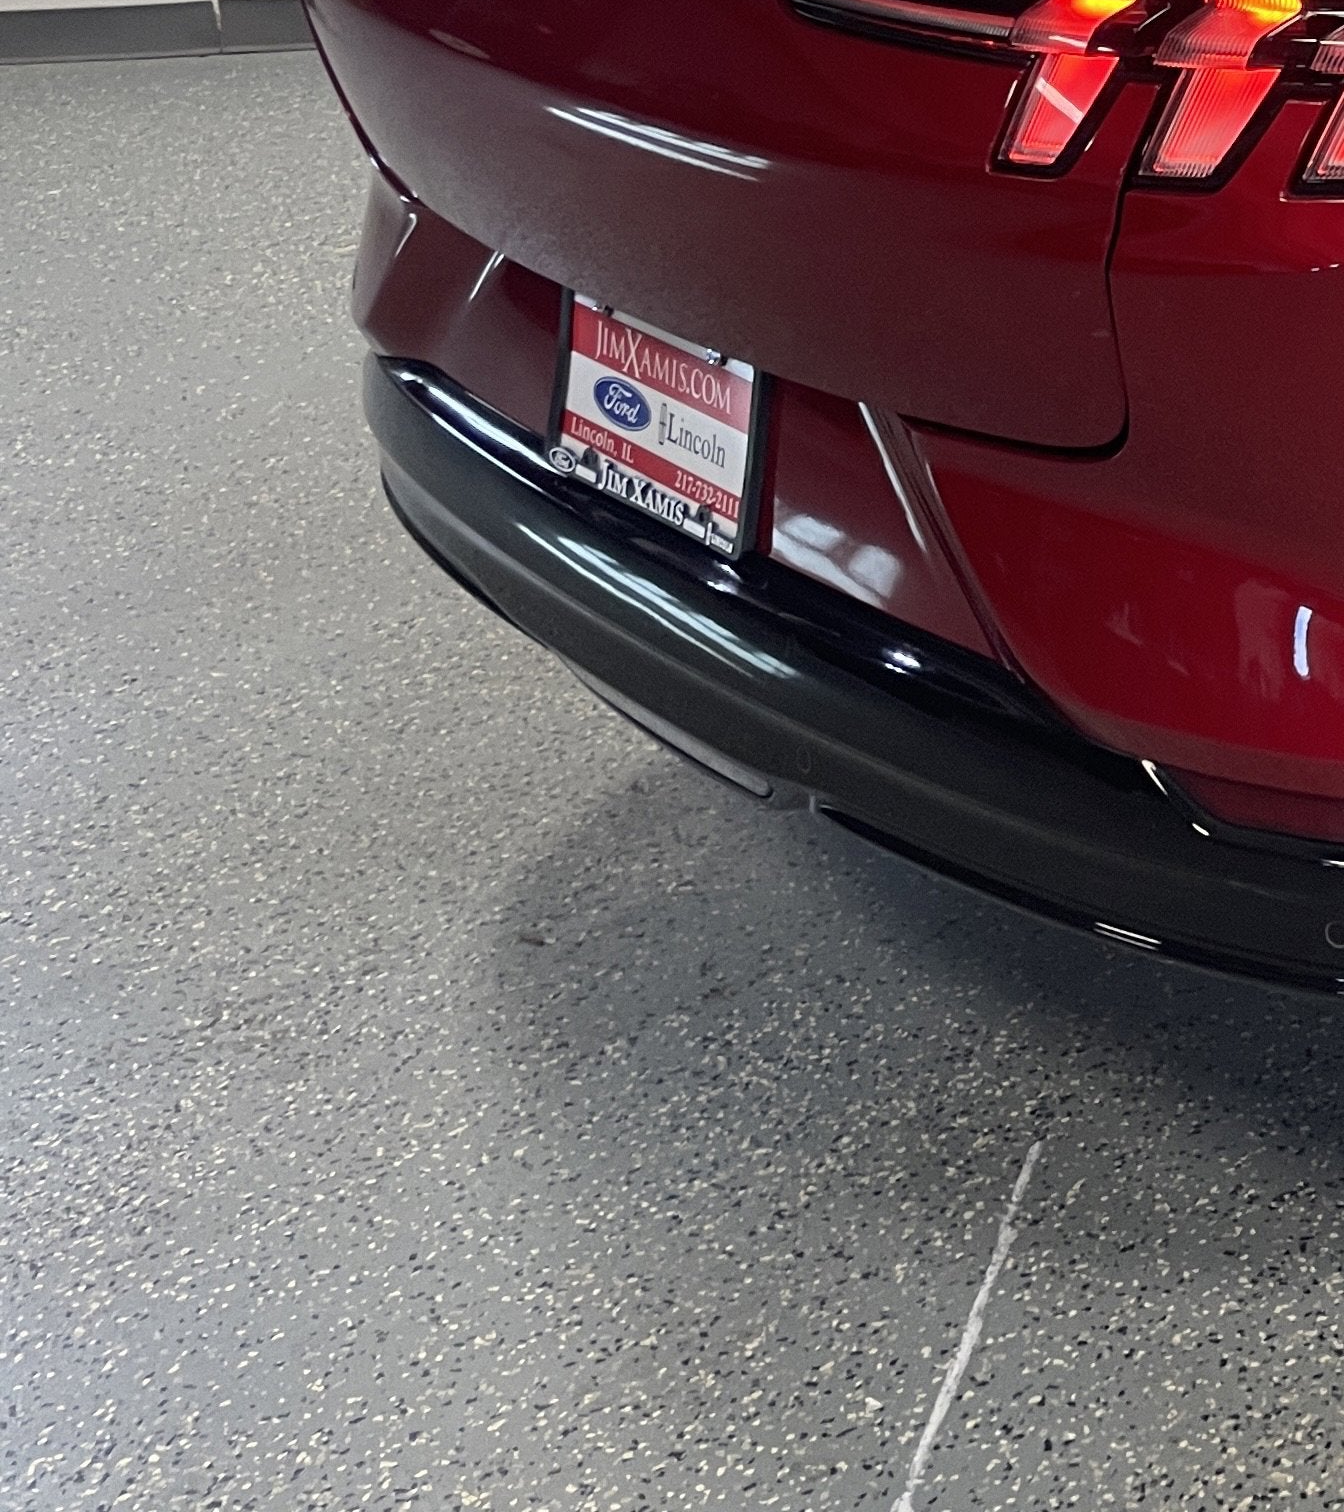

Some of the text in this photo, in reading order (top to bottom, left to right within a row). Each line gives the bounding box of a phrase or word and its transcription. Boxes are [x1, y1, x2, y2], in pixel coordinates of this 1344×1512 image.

[595, 320, 732, 414] JIMXAMIS.COM
[604, 383, 641, 423] Ford
[571, 417, 635, 464] Lincoln, IL
[667, 413, 726, 468] Lincoln
[598, 461, 686, 526] JIM XAMIS
[674, 471, 740, 519] 217-732-2111
